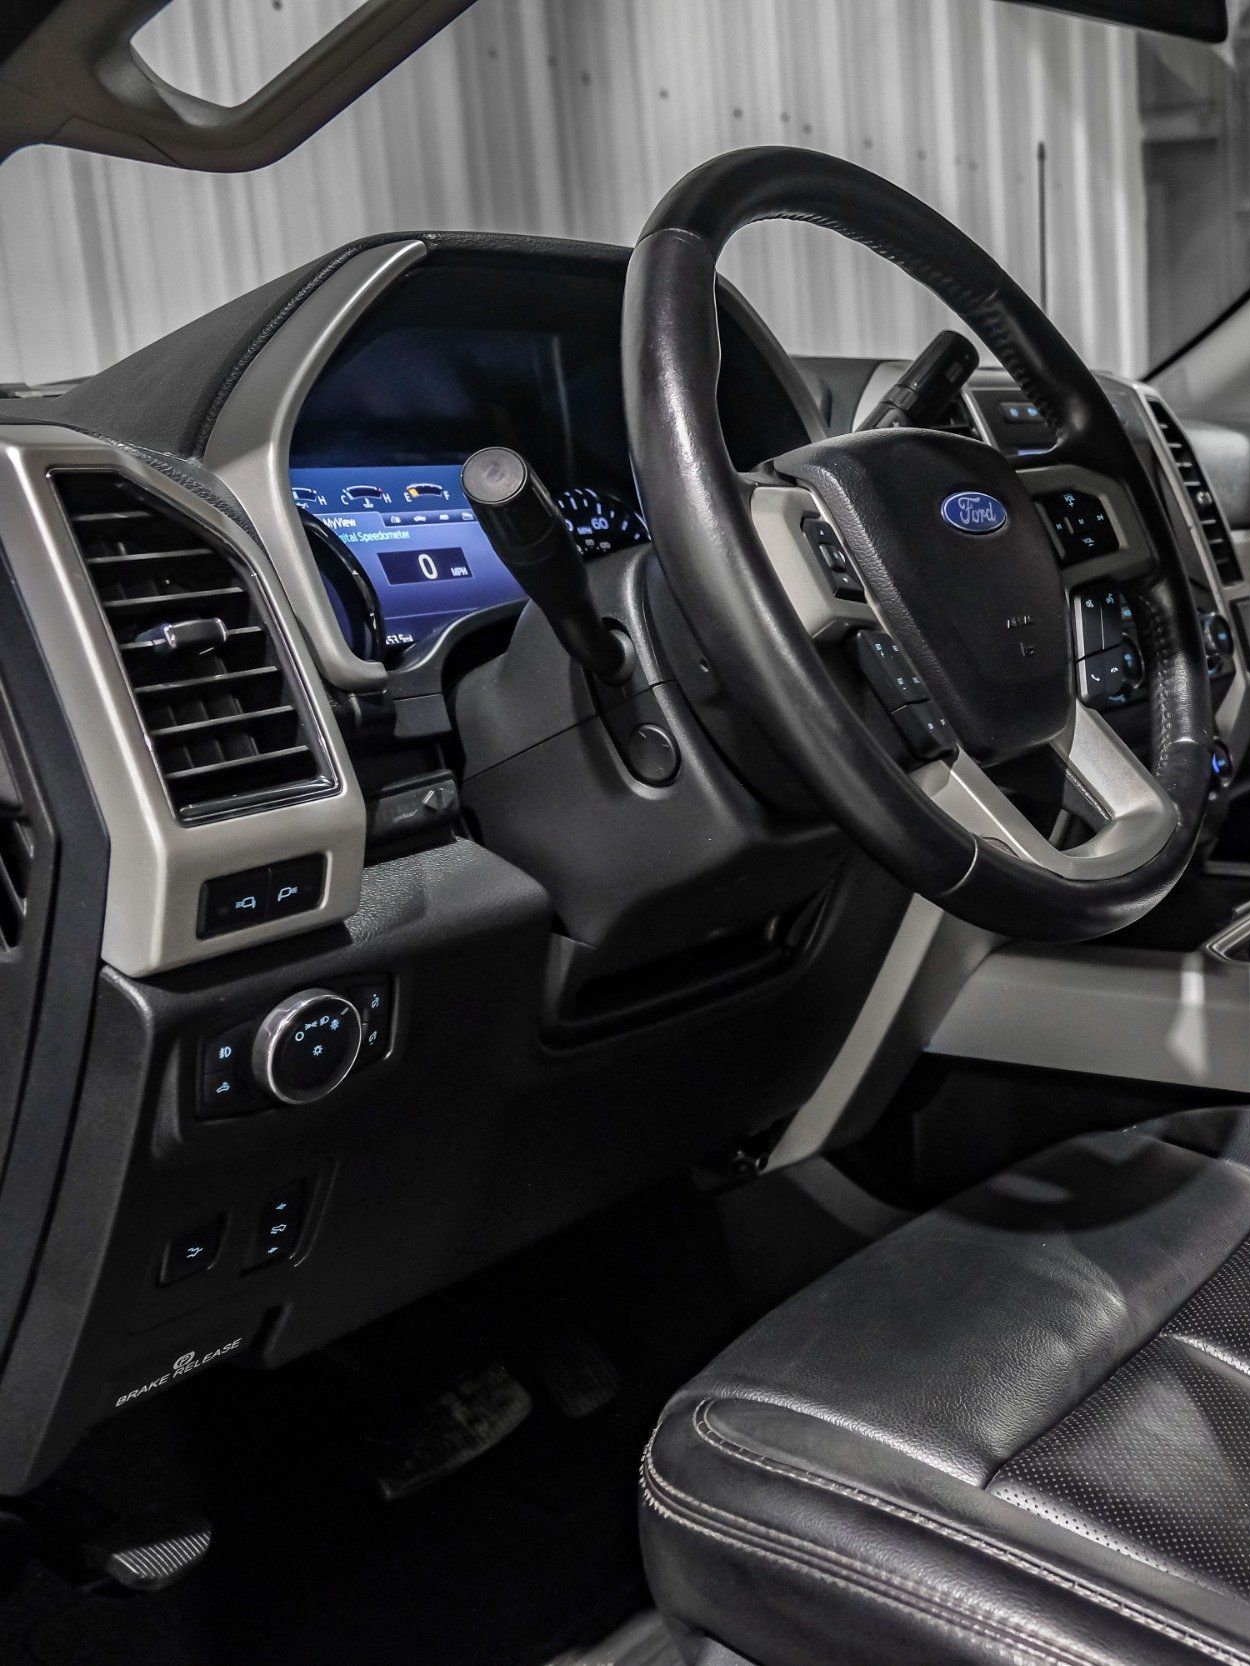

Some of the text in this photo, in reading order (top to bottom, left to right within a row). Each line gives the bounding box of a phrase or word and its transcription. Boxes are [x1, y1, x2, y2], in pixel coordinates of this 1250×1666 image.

[318, 496, 327, 505] H
[341, 493, 392, 505] C H
[403, 492, 412, 503] E
[957, 496, 997, 525] Ford
[322, 518, 356, 529] MyView
[591, 517, 609, 530] 60
[357, 531, 410, 542] Speedometer
[418, 553, 468, 580] 0 MPH
[115, 1337, 243, 1408] BRAKE RELEASE
